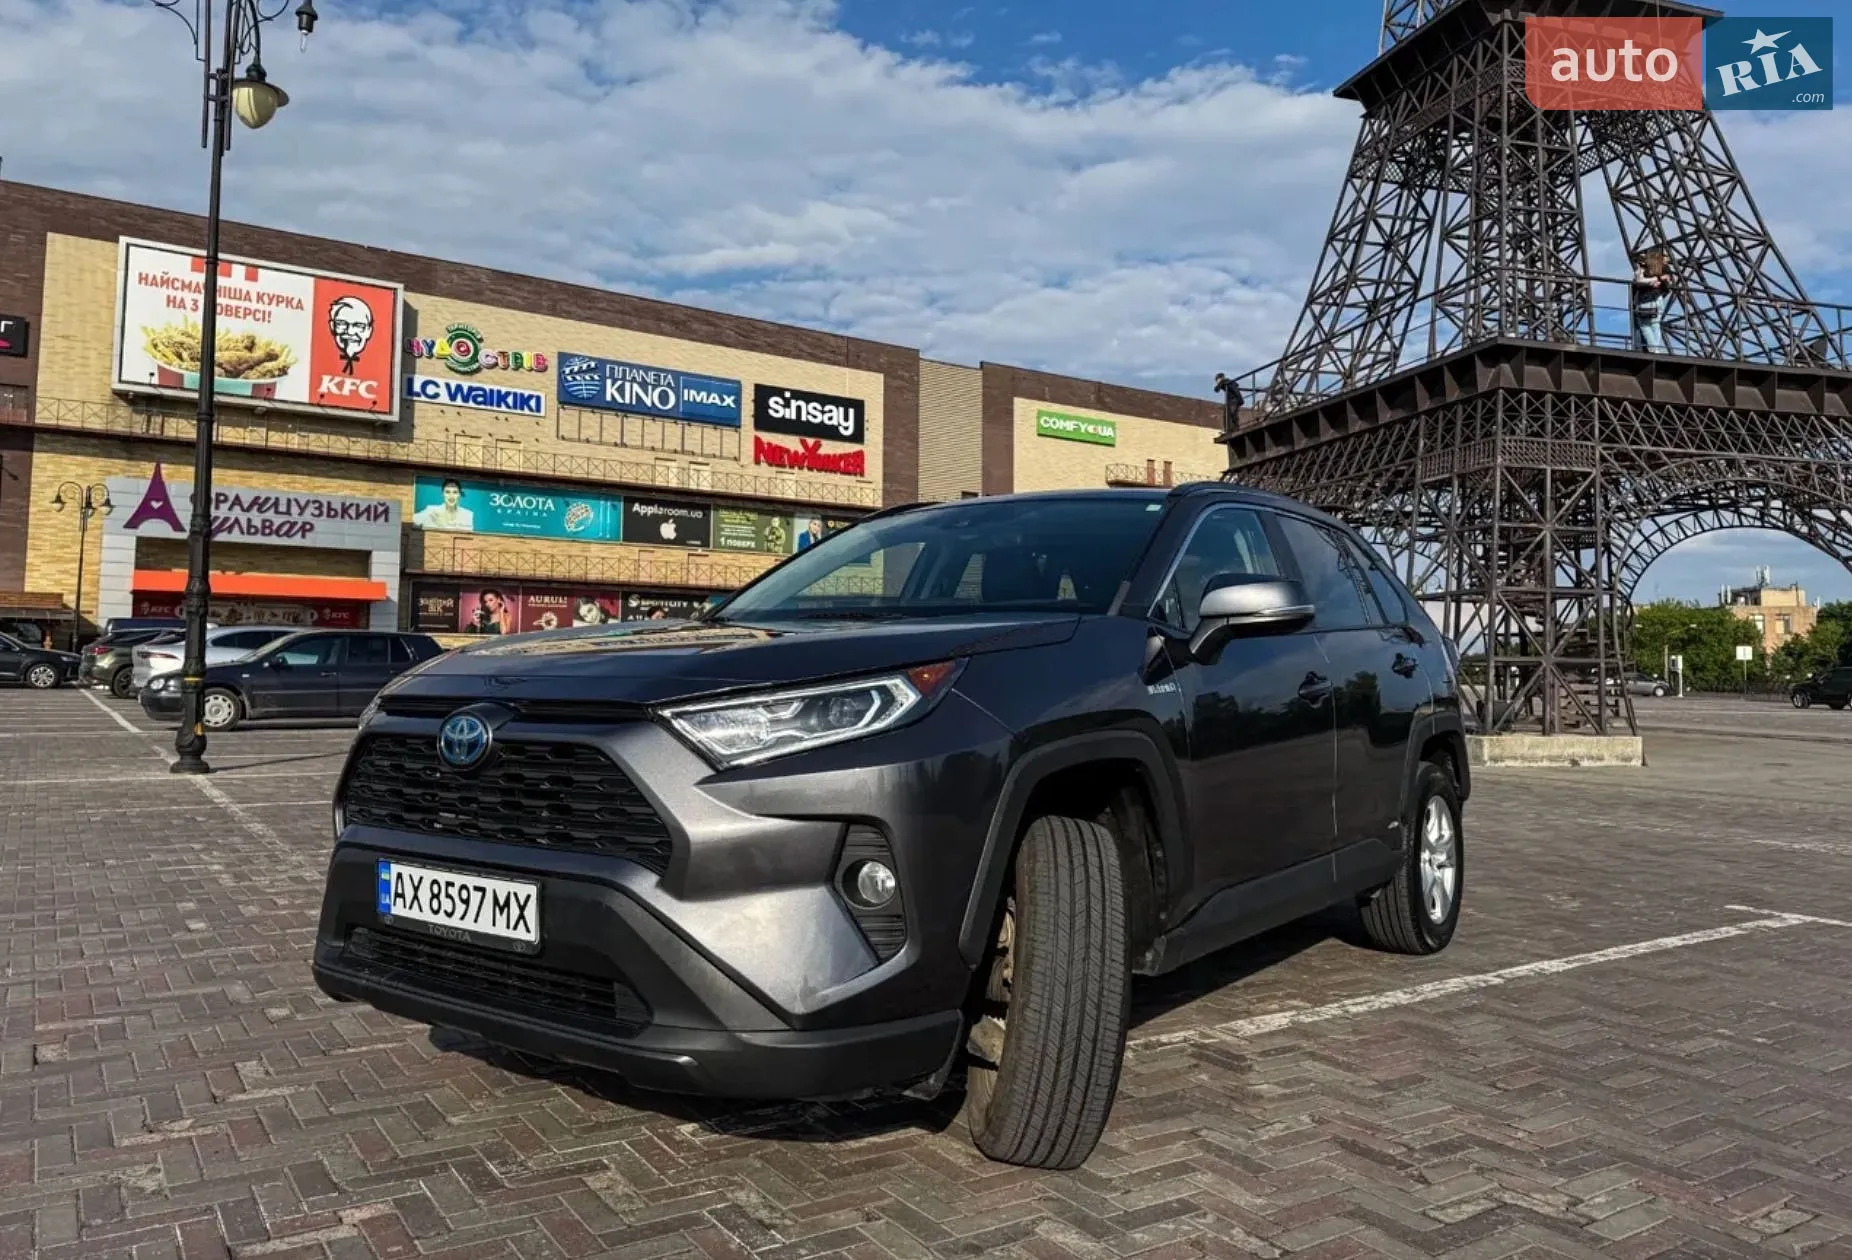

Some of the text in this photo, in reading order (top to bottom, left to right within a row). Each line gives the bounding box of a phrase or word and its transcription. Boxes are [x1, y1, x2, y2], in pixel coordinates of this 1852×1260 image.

[138, 271, 304, 311] НАЙСМАНІША КУРКА
[166, 295, 186, 310] НА
[215, 302, 272, 323] ОВЕРСІ!
[318, 374, 379, 399] KFC
[406, 377, 440, 399] LC
[683, 388, 736, 408] IMAX
[768, 391, 855, 436] sinsay
[189, 492, 390, 523] РАНЦУЗЬКИЙ
[489, 492, 556, 511] ЗОЛОТА
[209, 515, 314, 540] УЛЬВАР
[393, 871, 532, 934] AX 8597 MX
[428, 925, 472, 943] TOYOTA
